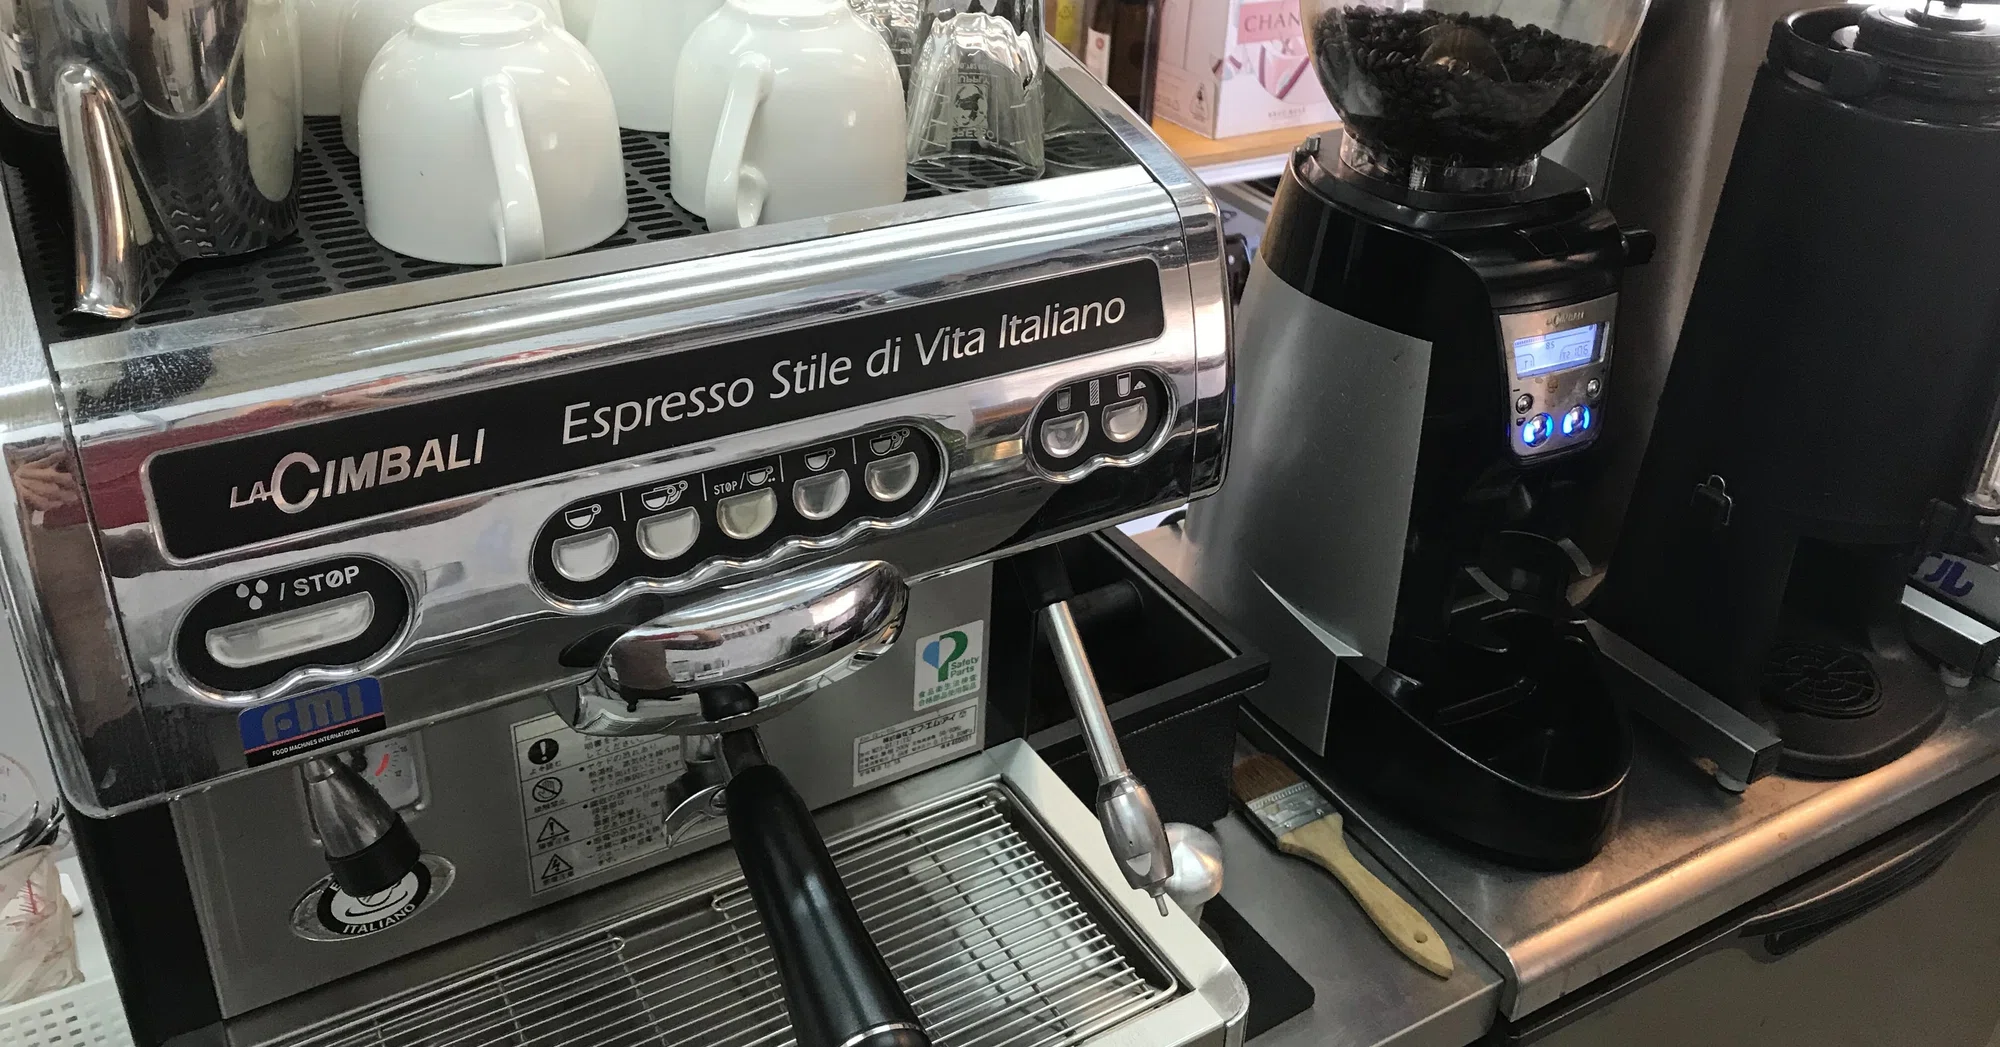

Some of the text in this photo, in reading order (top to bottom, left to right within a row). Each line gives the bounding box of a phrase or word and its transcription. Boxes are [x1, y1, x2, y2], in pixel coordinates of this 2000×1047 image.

[1244, 12, 1301, 33] CHAN
[562, 296, 1126, 446] Espresso Stile di Vita Italiano
[950, 656, 980, 670] Safety
[950, 666, 975, 678] Parts
[272, 727, 361, 757] FOOD MACHINES INTERNATIONAL
[342, 902, 416, 935] ITALIANO
